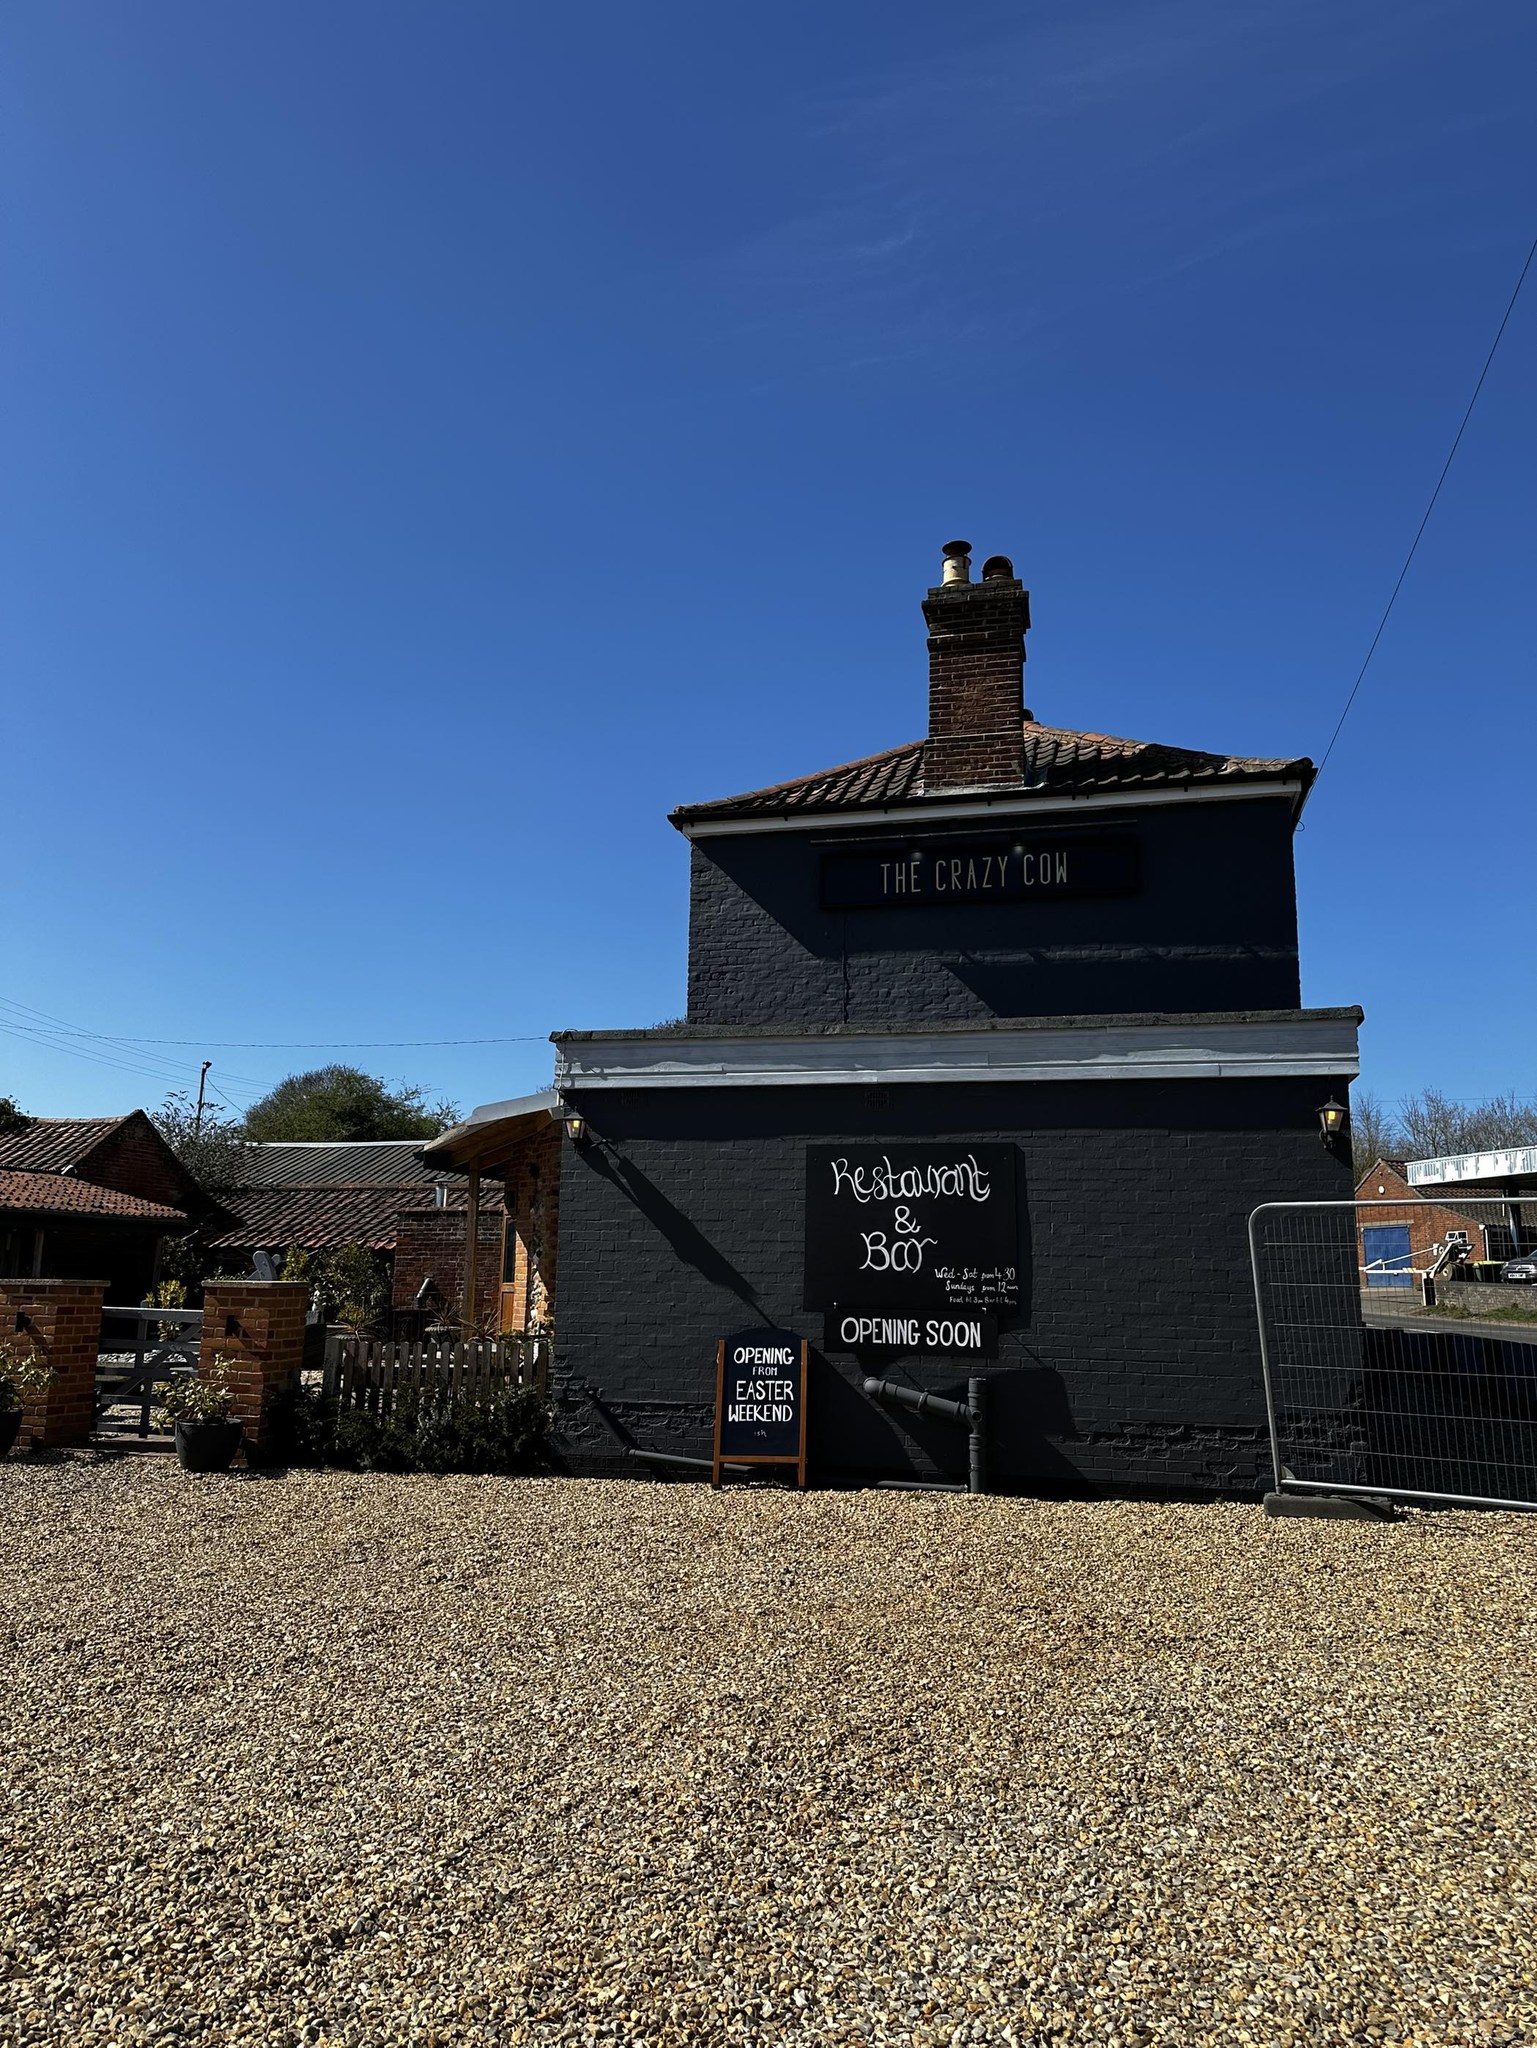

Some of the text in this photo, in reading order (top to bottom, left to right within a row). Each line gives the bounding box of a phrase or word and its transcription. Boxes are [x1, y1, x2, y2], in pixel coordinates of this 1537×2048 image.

[880, 852, 1067, 894] THE CRAZY COW
[831, 1154, 990, 1203] Restaurant
[894, 1205, 921, 1234] &
[859, 1231, 938, 1274] Bar
[934, 1267, 956, 1279] Wed
[962, 1267, 978, 1281] Sat
[945, 1280, 975, 1295] Sundays
[840, 1316, 982, 1349] OPENING SOON
[733, 1347, 795, 1365] OPENING
[752, 1366, 778, 1376] FROM
[736, 1380, 794, 1401] EASTER
[728, 1404, 793, 1422] WEEKEND
